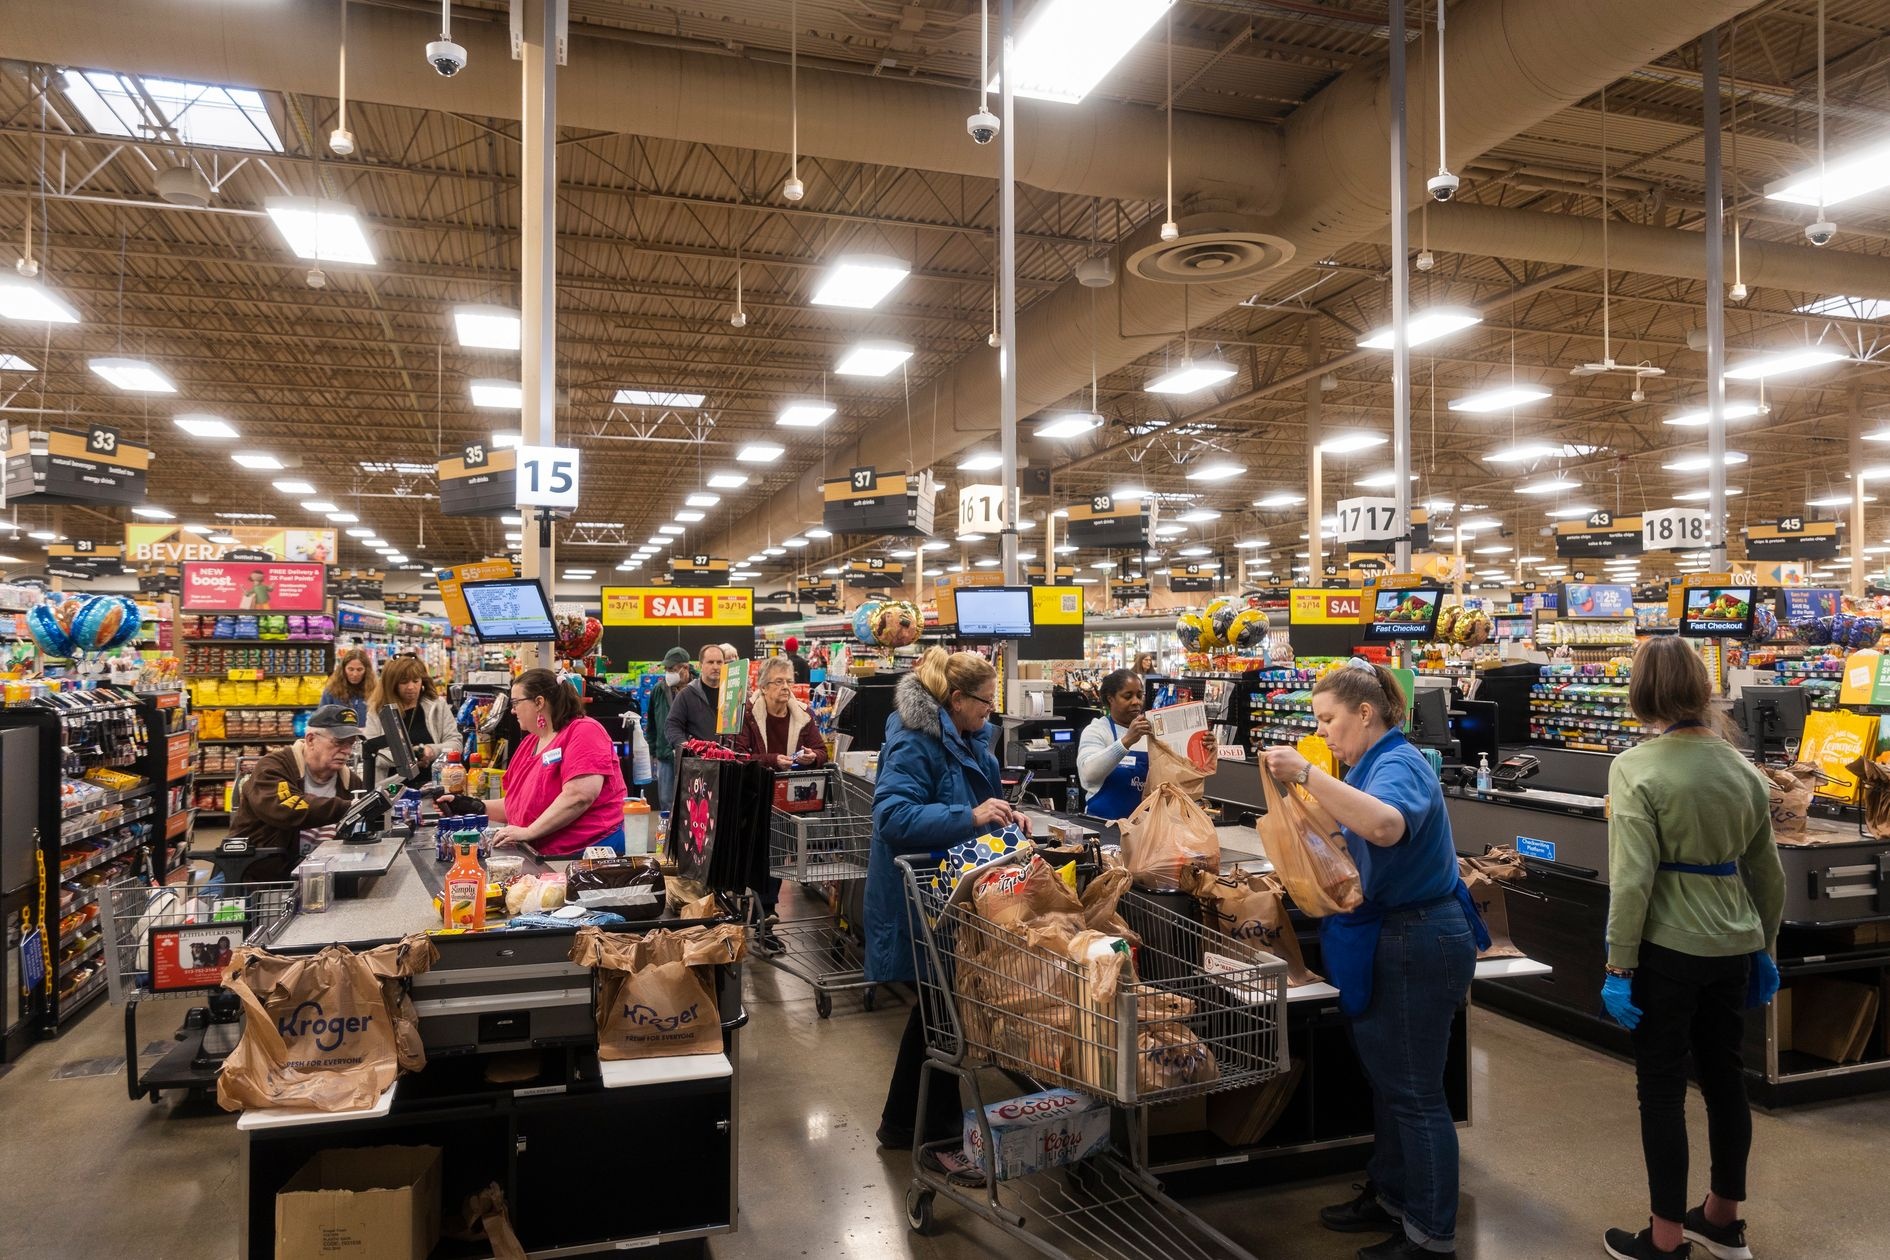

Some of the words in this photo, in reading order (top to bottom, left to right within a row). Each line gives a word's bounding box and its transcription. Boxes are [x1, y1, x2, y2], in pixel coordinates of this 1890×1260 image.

[93, 431, 115, 451] 33
[466, 446, 483, 464] 35
[524, 460, 572, 493] 15
[855, 471, 871, 488] 37
[961, 496, 973, 525] 16
[1094, 496, 1110, 510] 39
[1340, 507, 1360, 532] 17
[1367, 507, 1396, 530] 17
[1590, 514, 1609, 525] 43
[1781, 519, 1800, 530] 45
[1646, 518, 1673, 540] 18
[1679, 518, 1702, 539] 18
[78, 541, 92, 550] 31
[512, 554, 522, 563] 3
[696, 556, 708, 564] 37
[1188, 566, 1198, 574] 43
[1731, 573, 1758, 585] TOYS
[652, 598, 704, 616] SALE
[1330, 600, 1360, 614] SAL
[452, 886, 476, 895] Simply
[205, 928, 242, 937] FULKERSON
[1232, 920, 1283, 946] Kroger
[624, 1003, 698, 1032] Kroger
[279, 1001, 373, 1052] Kroger
[324, 1057, 362, 1065] EVERYONE
[991, 1095, 1078, 1120] Coors
[1026, 1106, 1073, 1122] LIGHT
[1044, 1132, 1082, 1152] Coors
[1048, 1144, 1078, 1160] LIGHT
